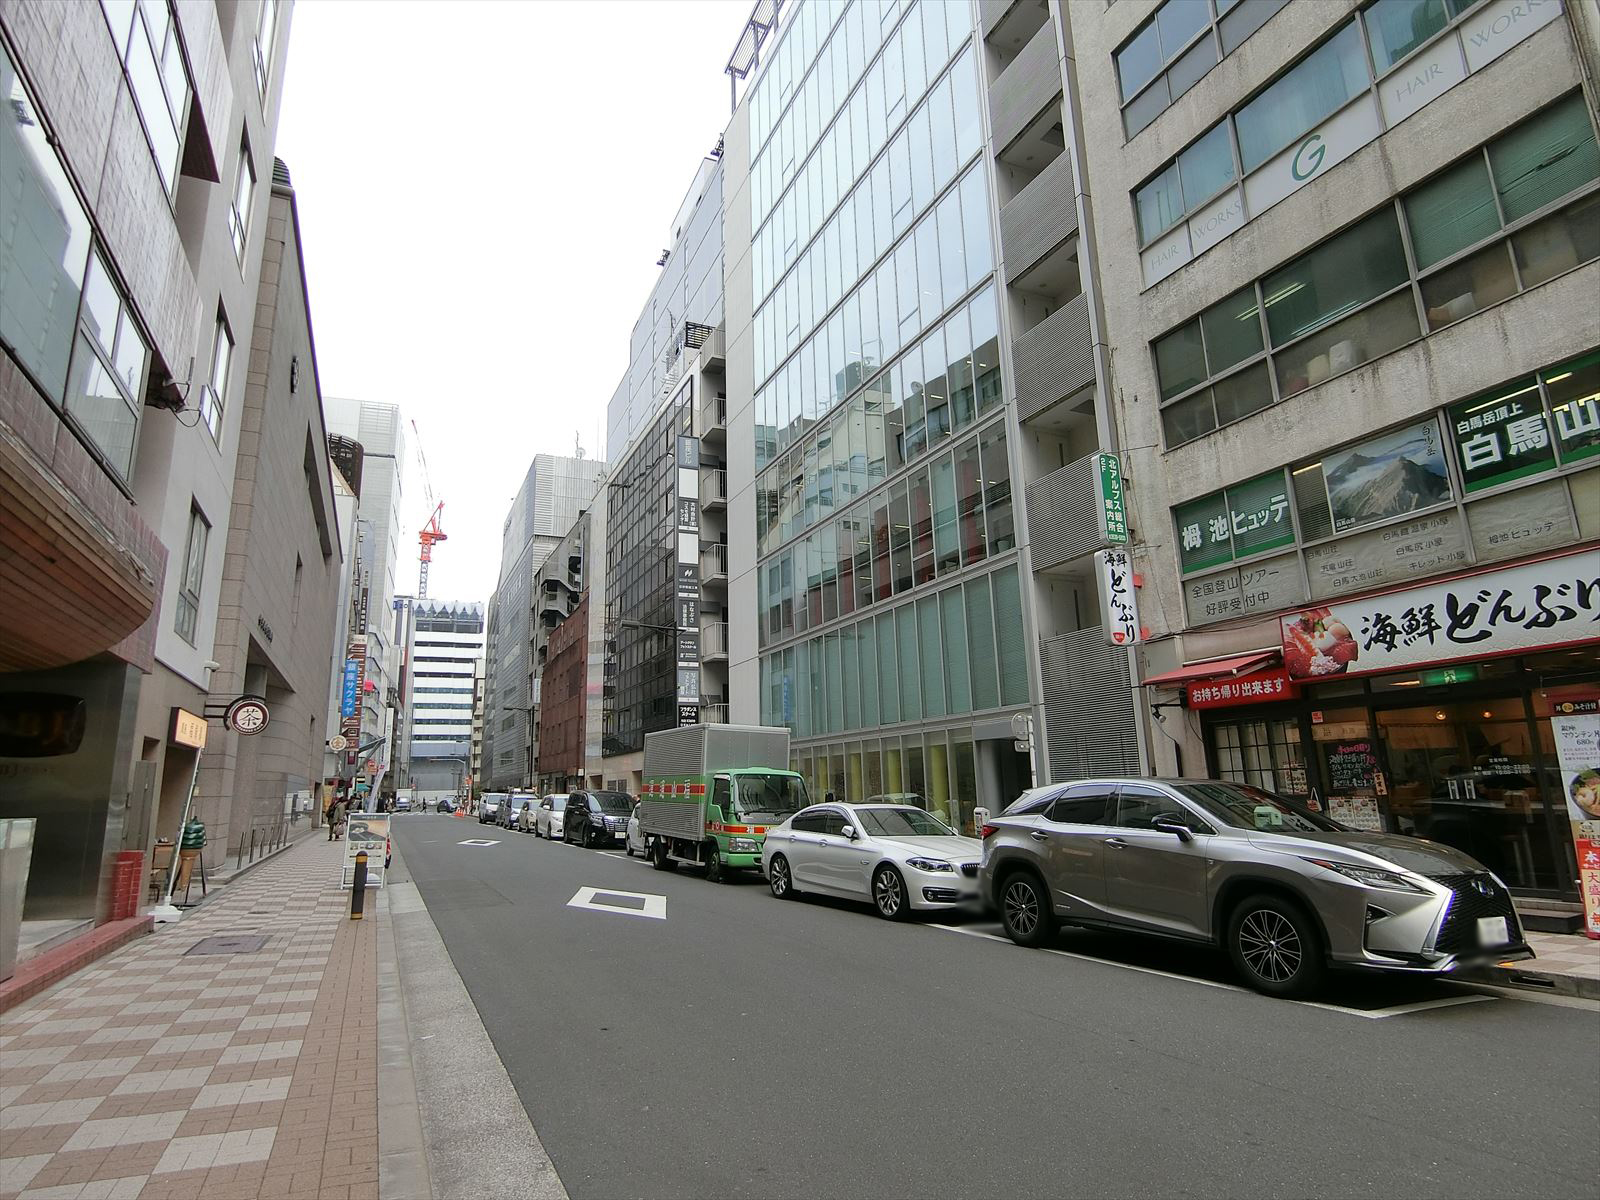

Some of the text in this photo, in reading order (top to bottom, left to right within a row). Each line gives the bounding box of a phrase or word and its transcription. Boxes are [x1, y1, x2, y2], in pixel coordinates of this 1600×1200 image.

[1396, 0, 1543, 102] HAIR WORK
[1291, 134, 1326, 181] G
[1151, 200, 1241, 270] HAIR WORKS
[1457, 402, 1523, 434] 白馬岳頂上
[1101, 458, 1106, 472] 2F
[1109, 459, 1124, 532] 北アルプス総合
[1106, 500, 1116, 531] 案内所
[1182, 494, 1288, 551] 栂池ヒュッテ
[1489, 522, 1554, 544] 栂池ヒュッテ
[1104, 552, 1128, 569] 海鮮
[1307, 545, 1338, 559] 白馬山荘
[1409, 551, 1466, 570] キレット小屋
[1192, 569, 1280, 598] 全国登山ツアー
[1333, 569, 1384, 587] 白馬大池山荘
[1111, 569, 1135, 643] どんぶり
[1206, 591, 1270, 616] 好評受付中
[1192, 677, 1284, 702] お持ち帰り出来ます
[240, 708, 261, 727] 茶
